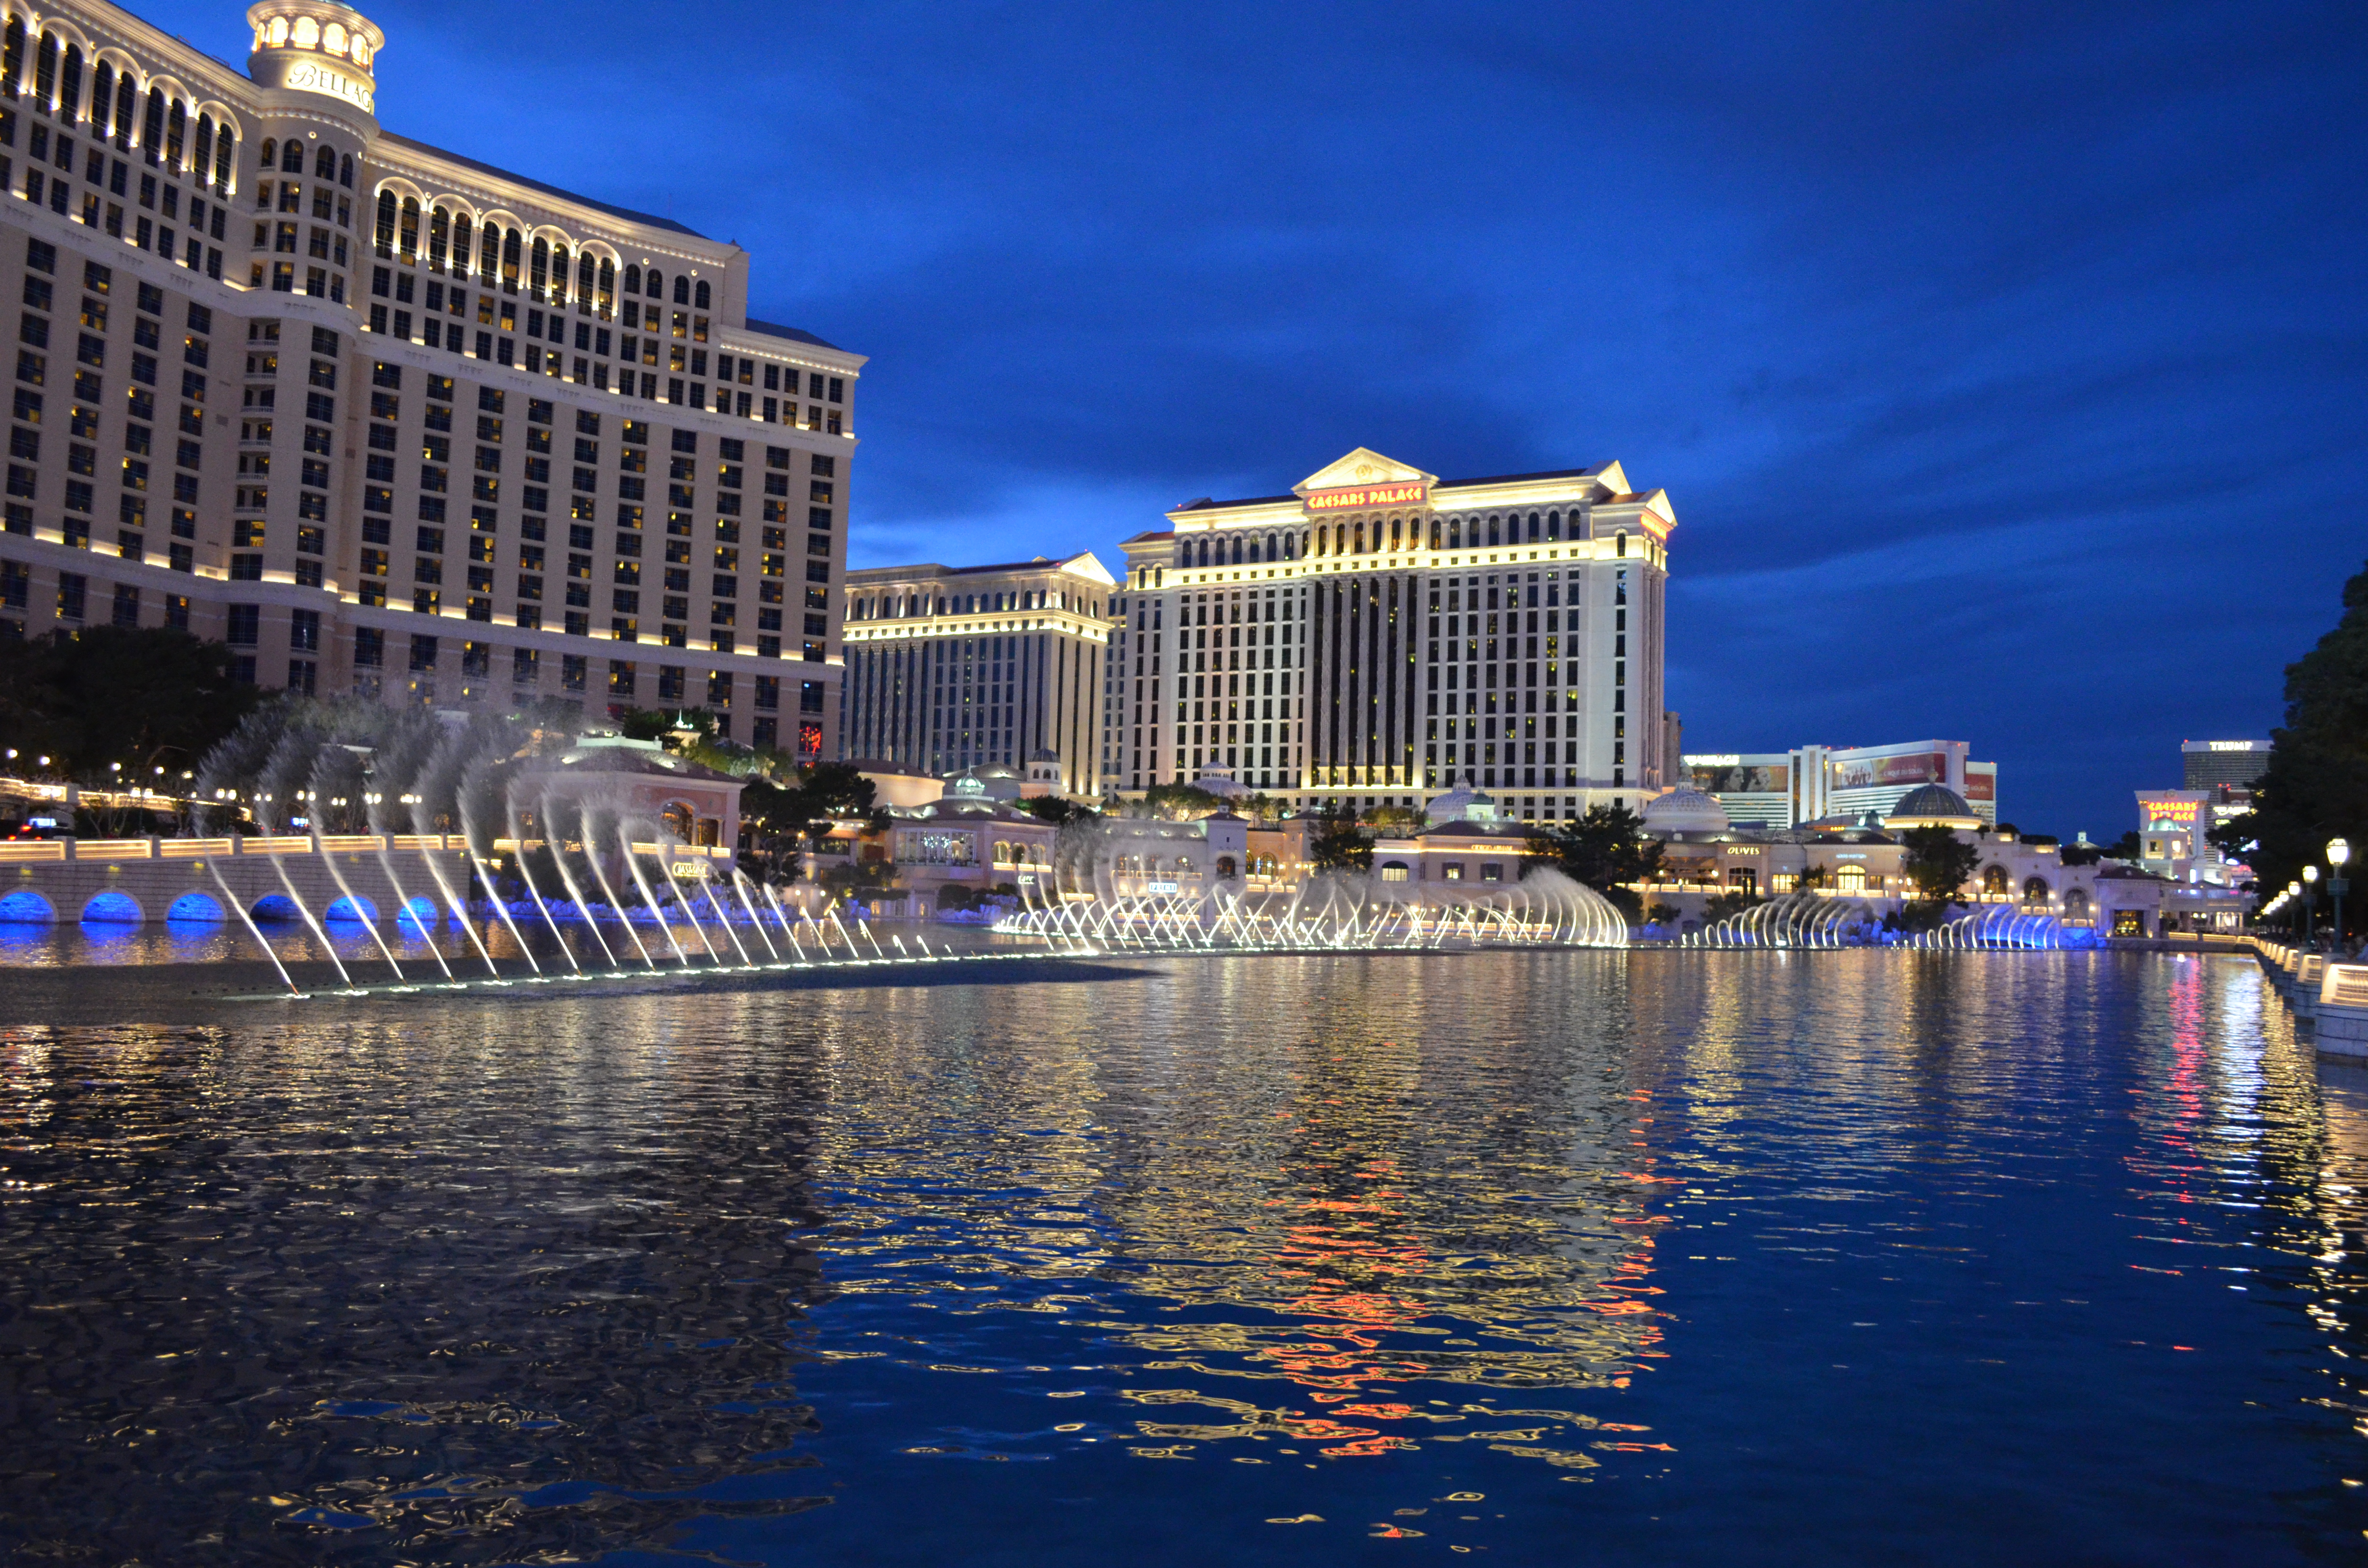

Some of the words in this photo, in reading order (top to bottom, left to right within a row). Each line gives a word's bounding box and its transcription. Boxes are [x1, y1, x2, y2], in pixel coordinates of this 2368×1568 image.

[1307, 492, 1365, 510] CAESARS
[1369, 487, 1422, 504] PALACE
[2209, 741, 2253, 751] TRUMP
[2147, 801, 2198, 812] CAESARS
[1727, 846, 1760, 855] OLIVES
